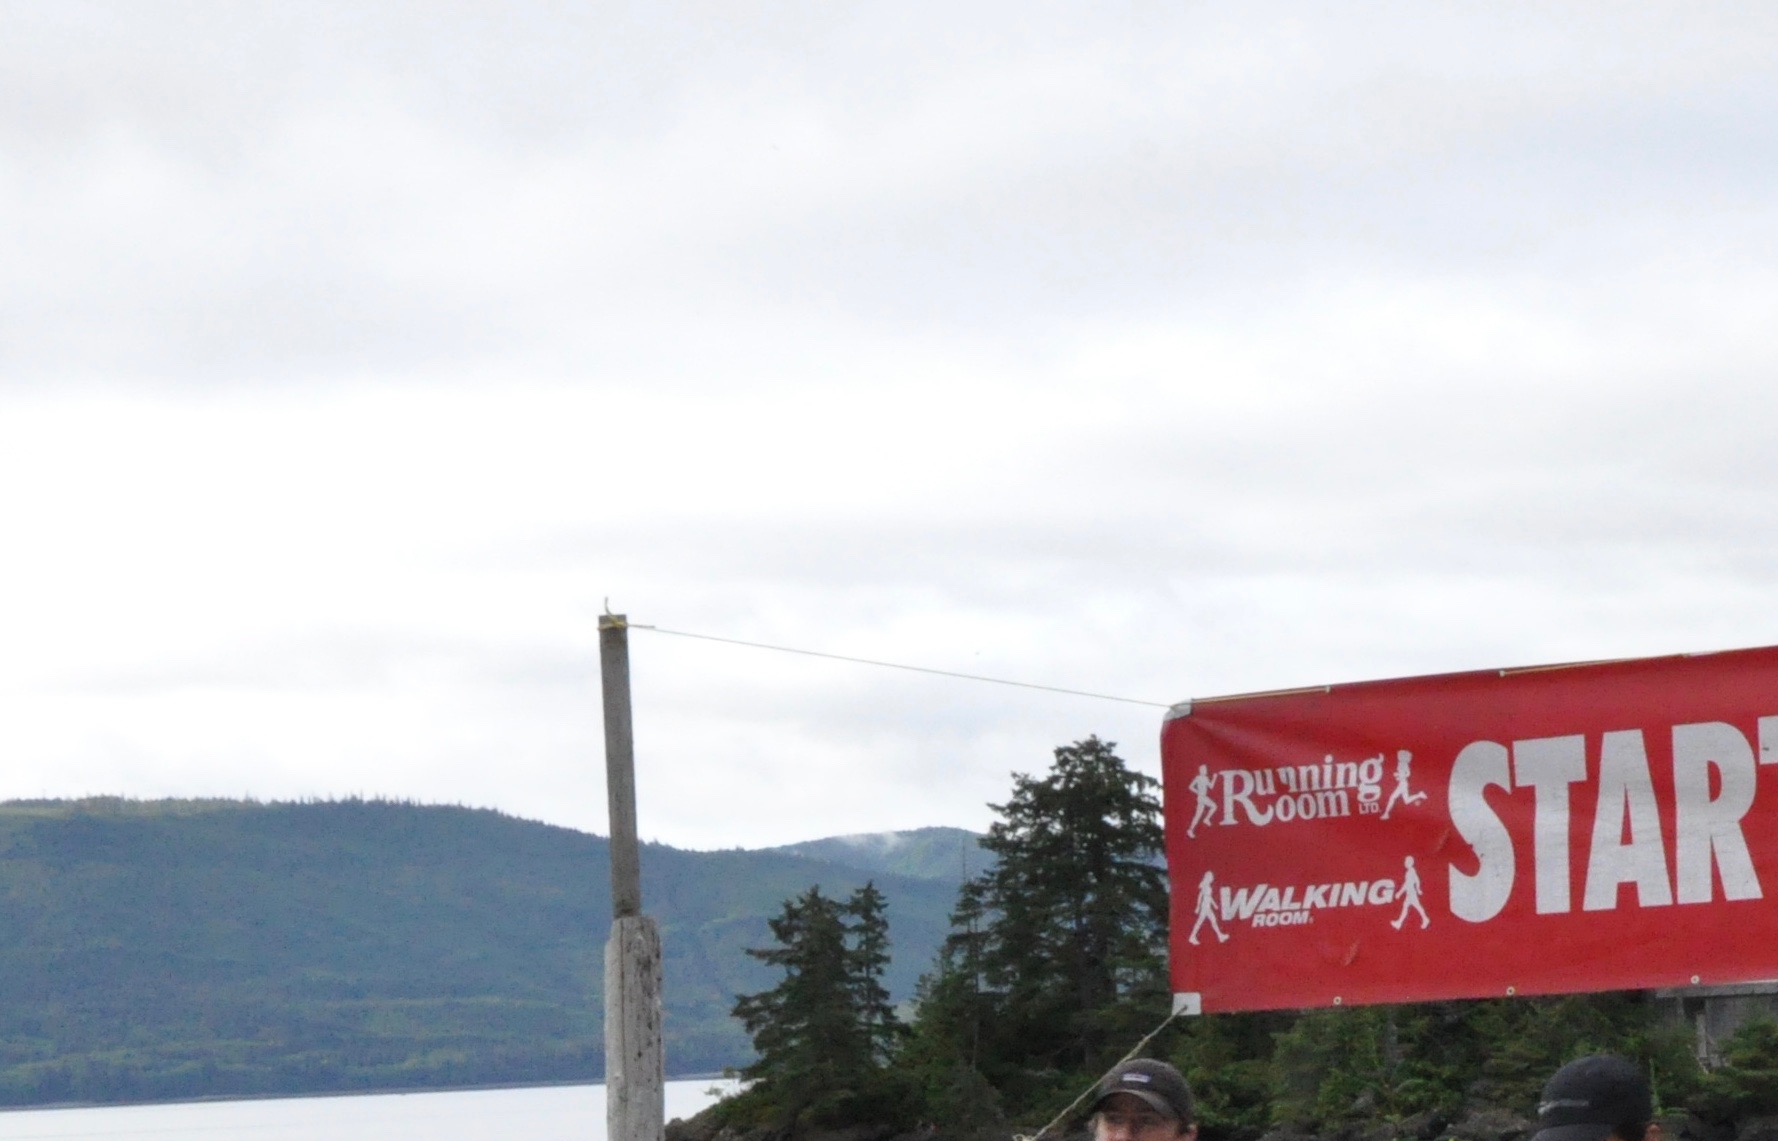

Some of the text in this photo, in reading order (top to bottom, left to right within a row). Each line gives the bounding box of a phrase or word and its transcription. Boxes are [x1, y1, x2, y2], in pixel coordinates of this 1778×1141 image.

[1218, 753, 1385, 826] Running
[1219, 879, 1396, 921] WALKING
[1252, 910, 1310, 928] ROOM
